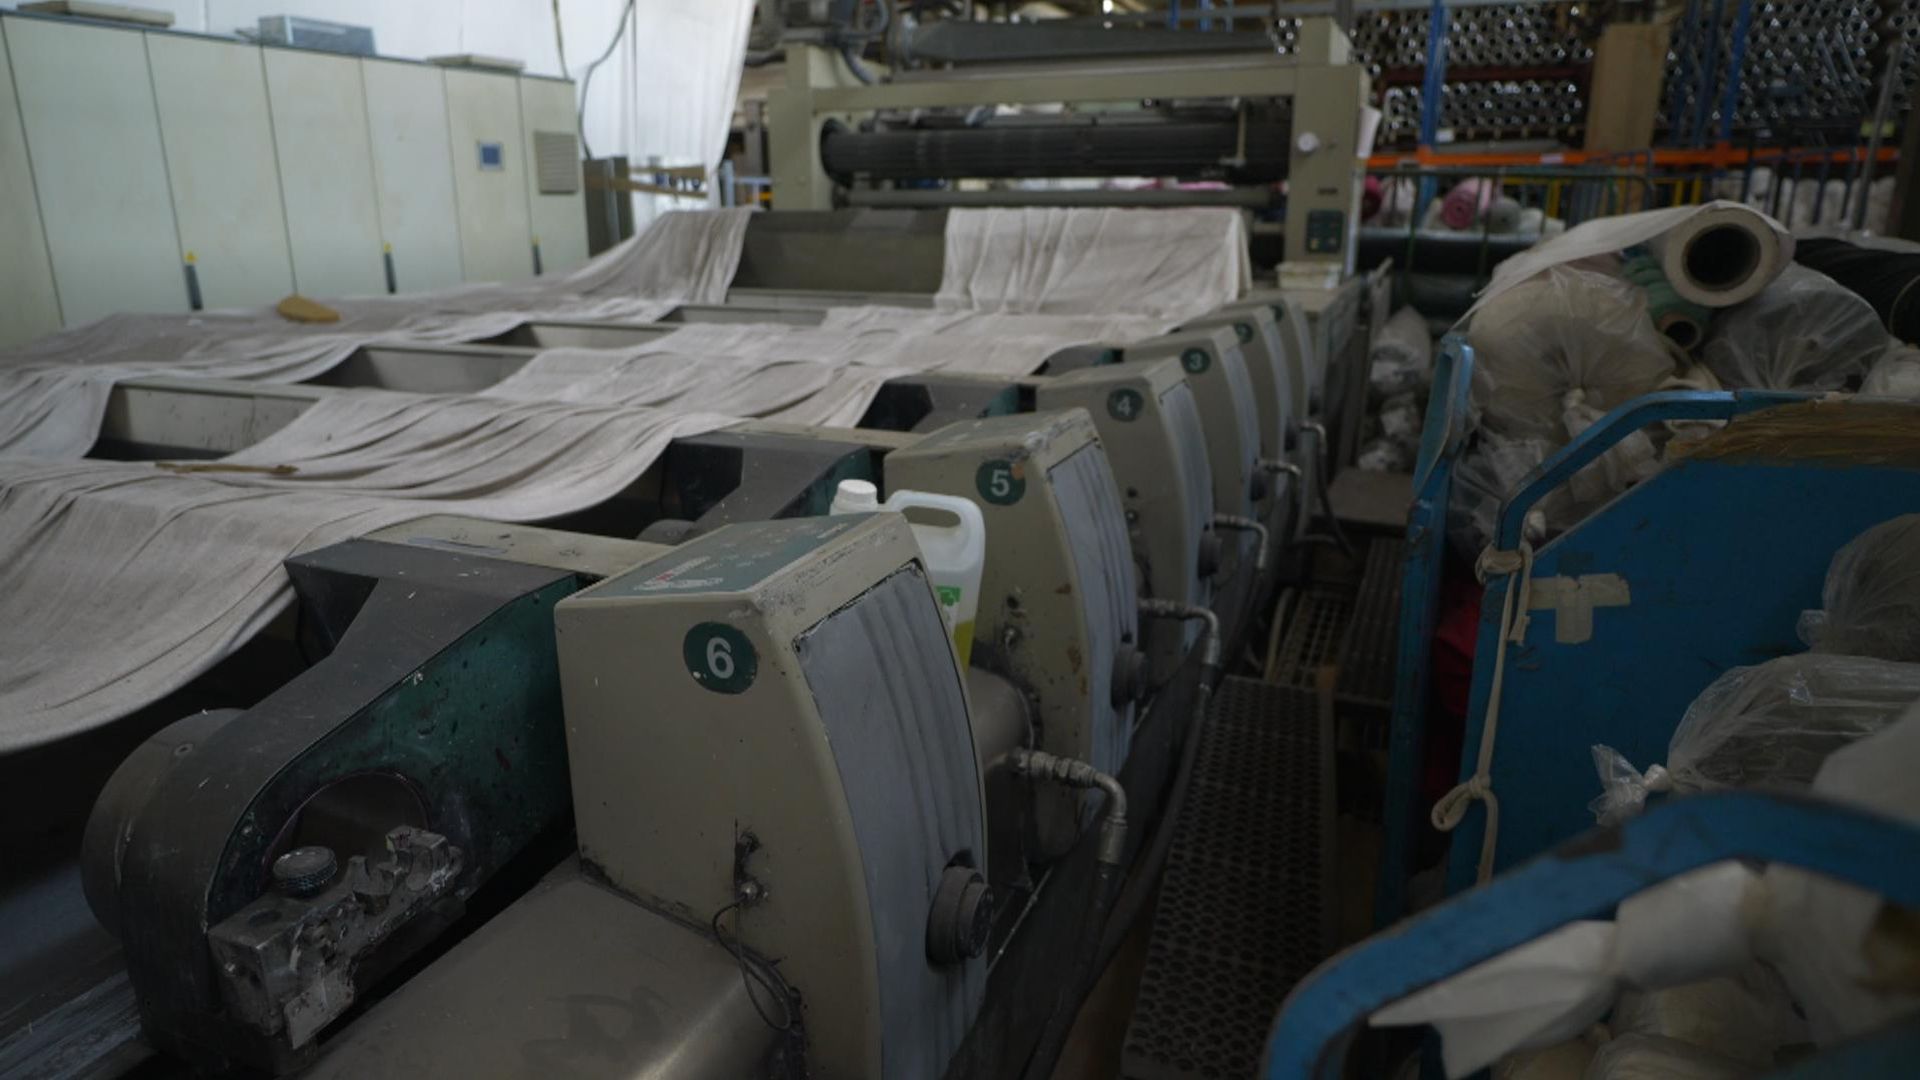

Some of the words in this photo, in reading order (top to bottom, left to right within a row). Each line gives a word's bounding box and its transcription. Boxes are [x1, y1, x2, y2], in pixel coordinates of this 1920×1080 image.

[1189, 352, 1203, 370] 3
[1117, 395, 1131, 416] 4
[990, 469, 1010, 497] 5
[706, 636, 735, 679] 6
